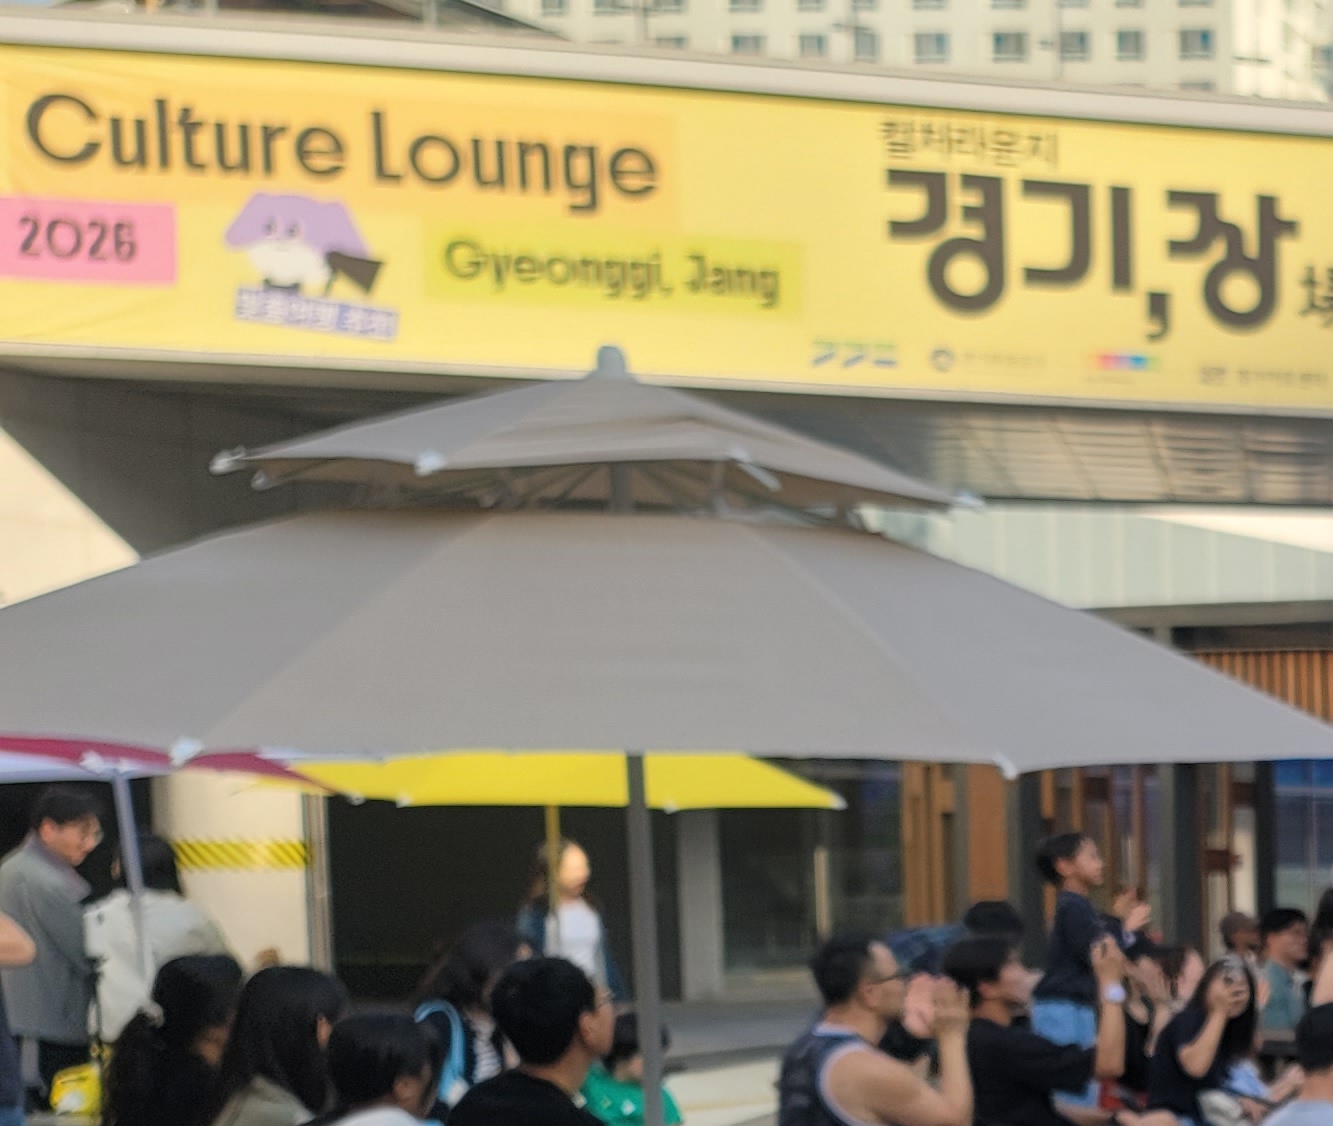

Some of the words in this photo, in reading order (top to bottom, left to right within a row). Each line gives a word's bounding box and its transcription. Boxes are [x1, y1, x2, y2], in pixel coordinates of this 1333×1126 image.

[26, 94, 345, 175] Culture
[370, 110, 657, 213] Lounge
[881, 120, 1059, 169] 컬처라운지
[19, 216, 137, 262] 2026
[887, 167, 1299, 342] 경기,장
[445, 240, 673, 299] Gyeonggi,
[685, 252, 780, 308] Jang
